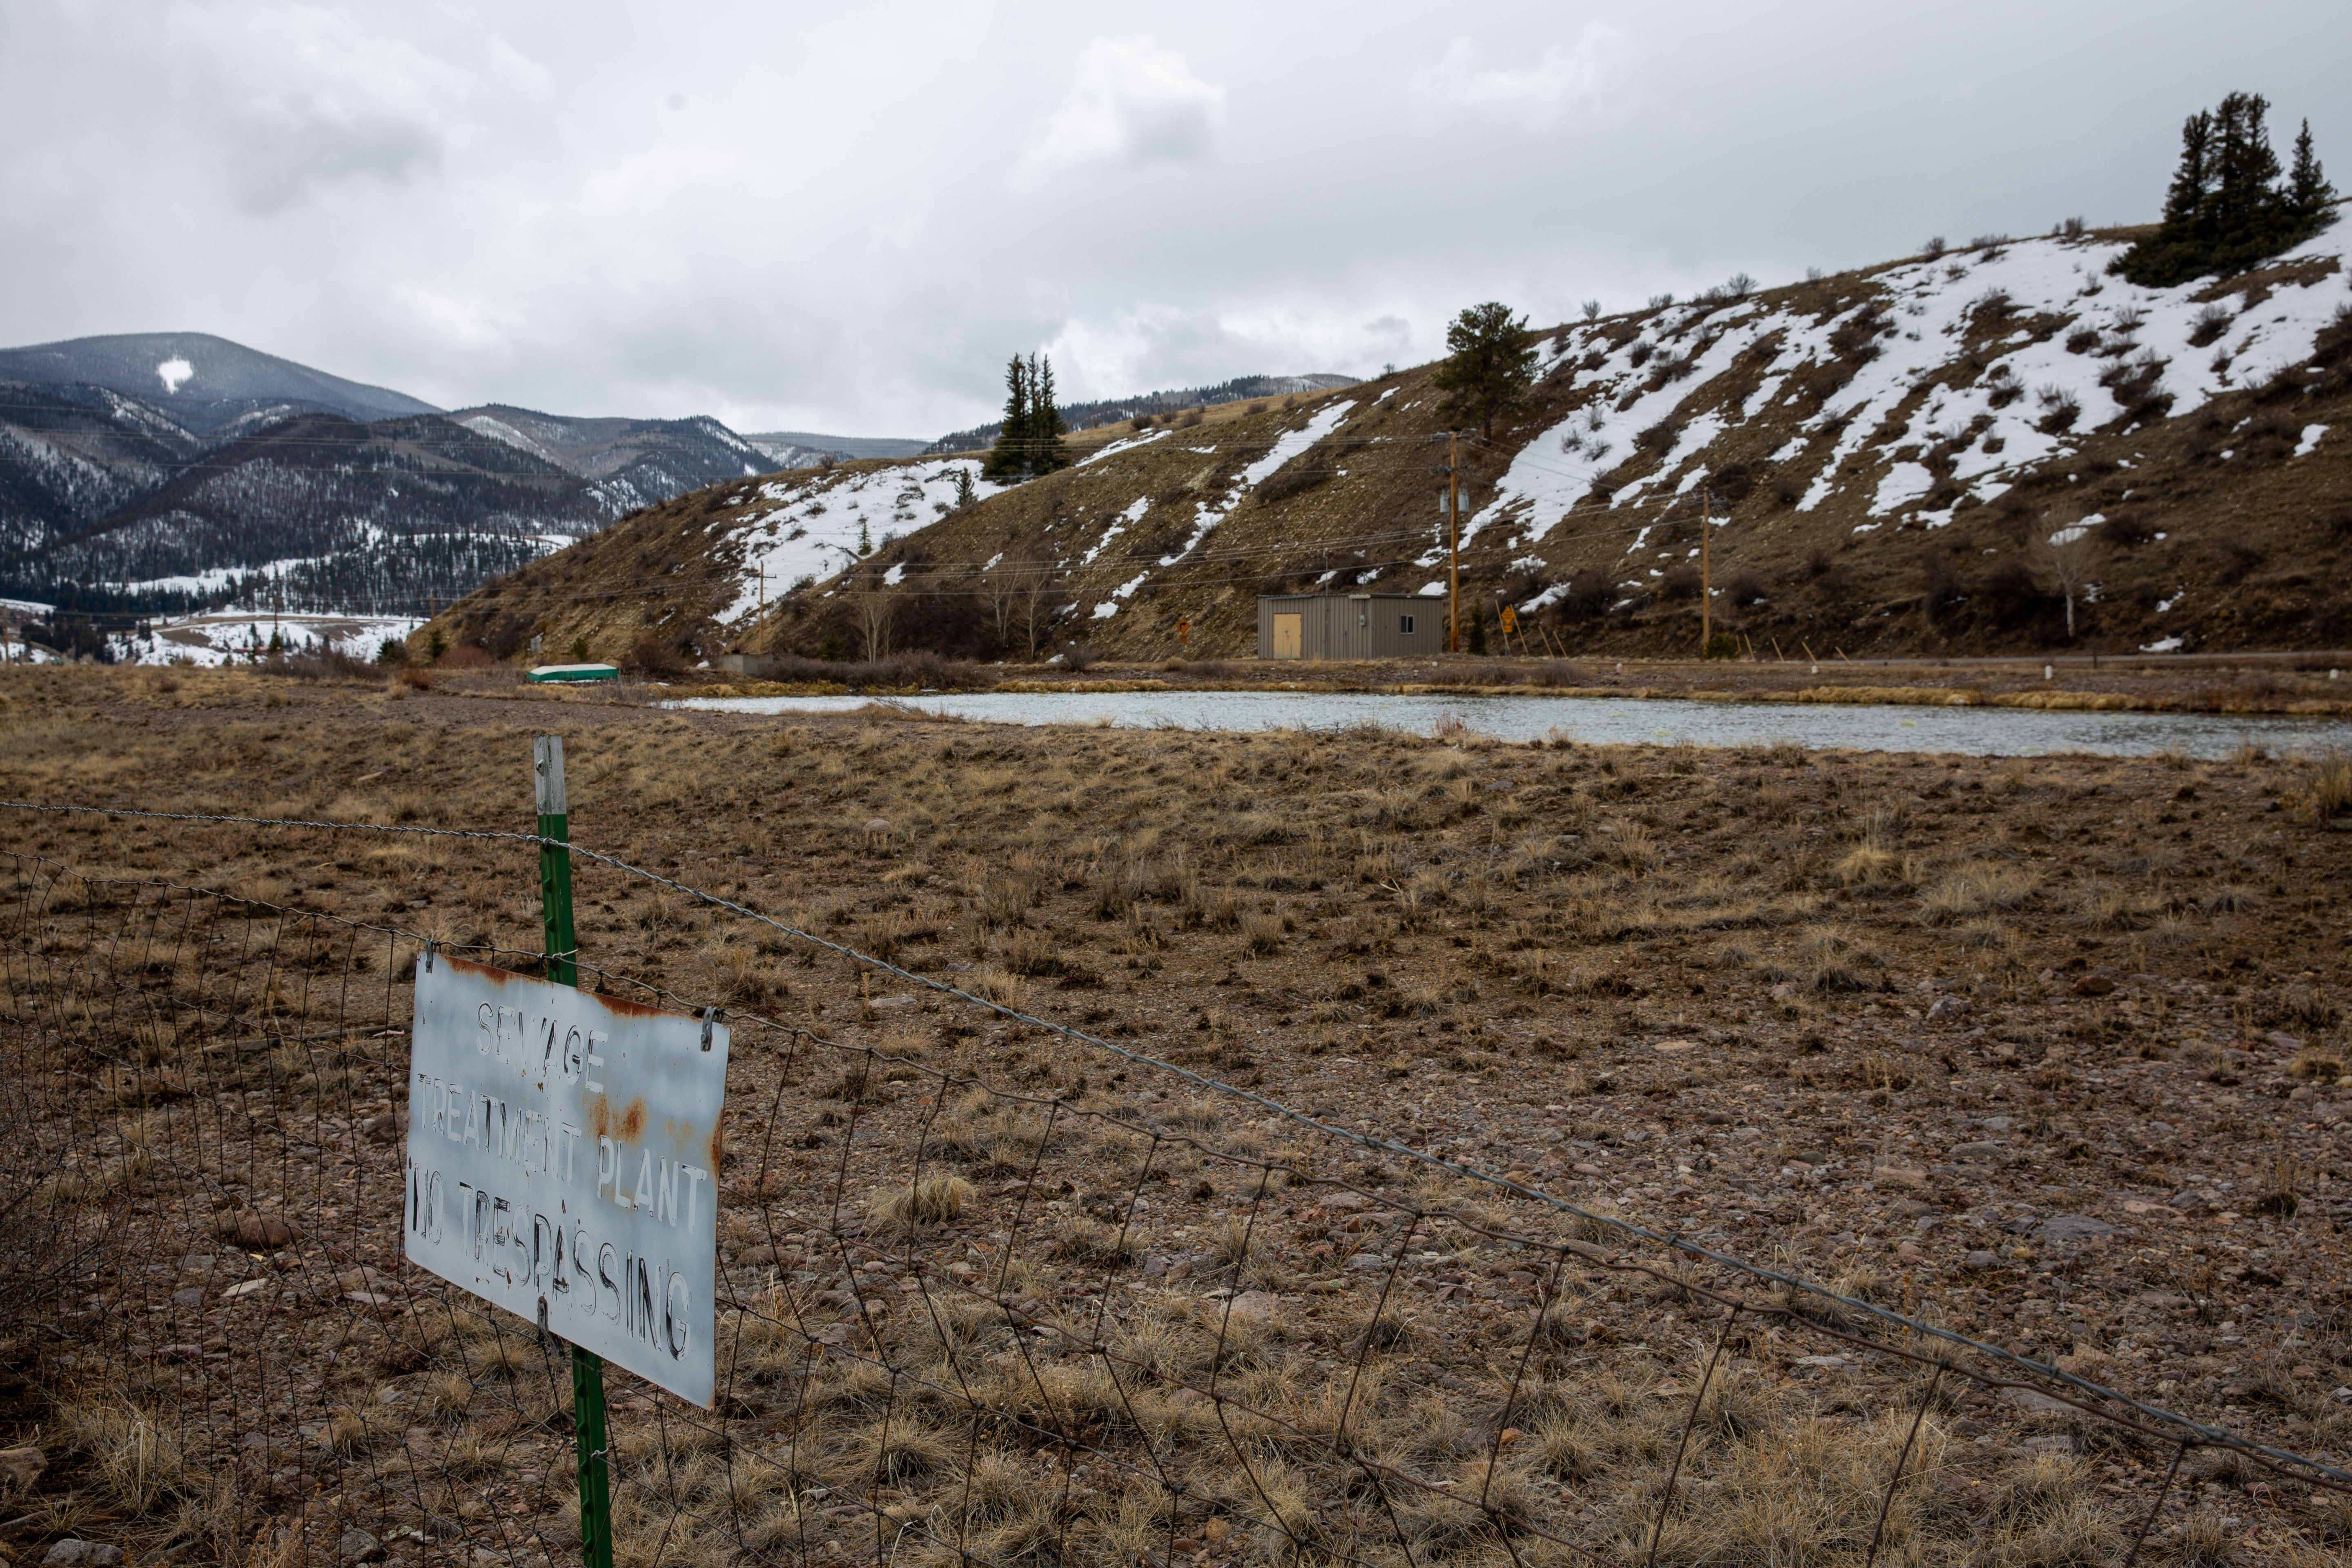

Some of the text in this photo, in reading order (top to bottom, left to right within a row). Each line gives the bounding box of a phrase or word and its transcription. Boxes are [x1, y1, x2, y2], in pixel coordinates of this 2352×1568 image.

[476, 1000, 608, 1094] SEWAGE
[418, 1073, 708, 1234] TREATMENT PLANT
[412, 1163, 690, 1362] NO TRESPASSING
